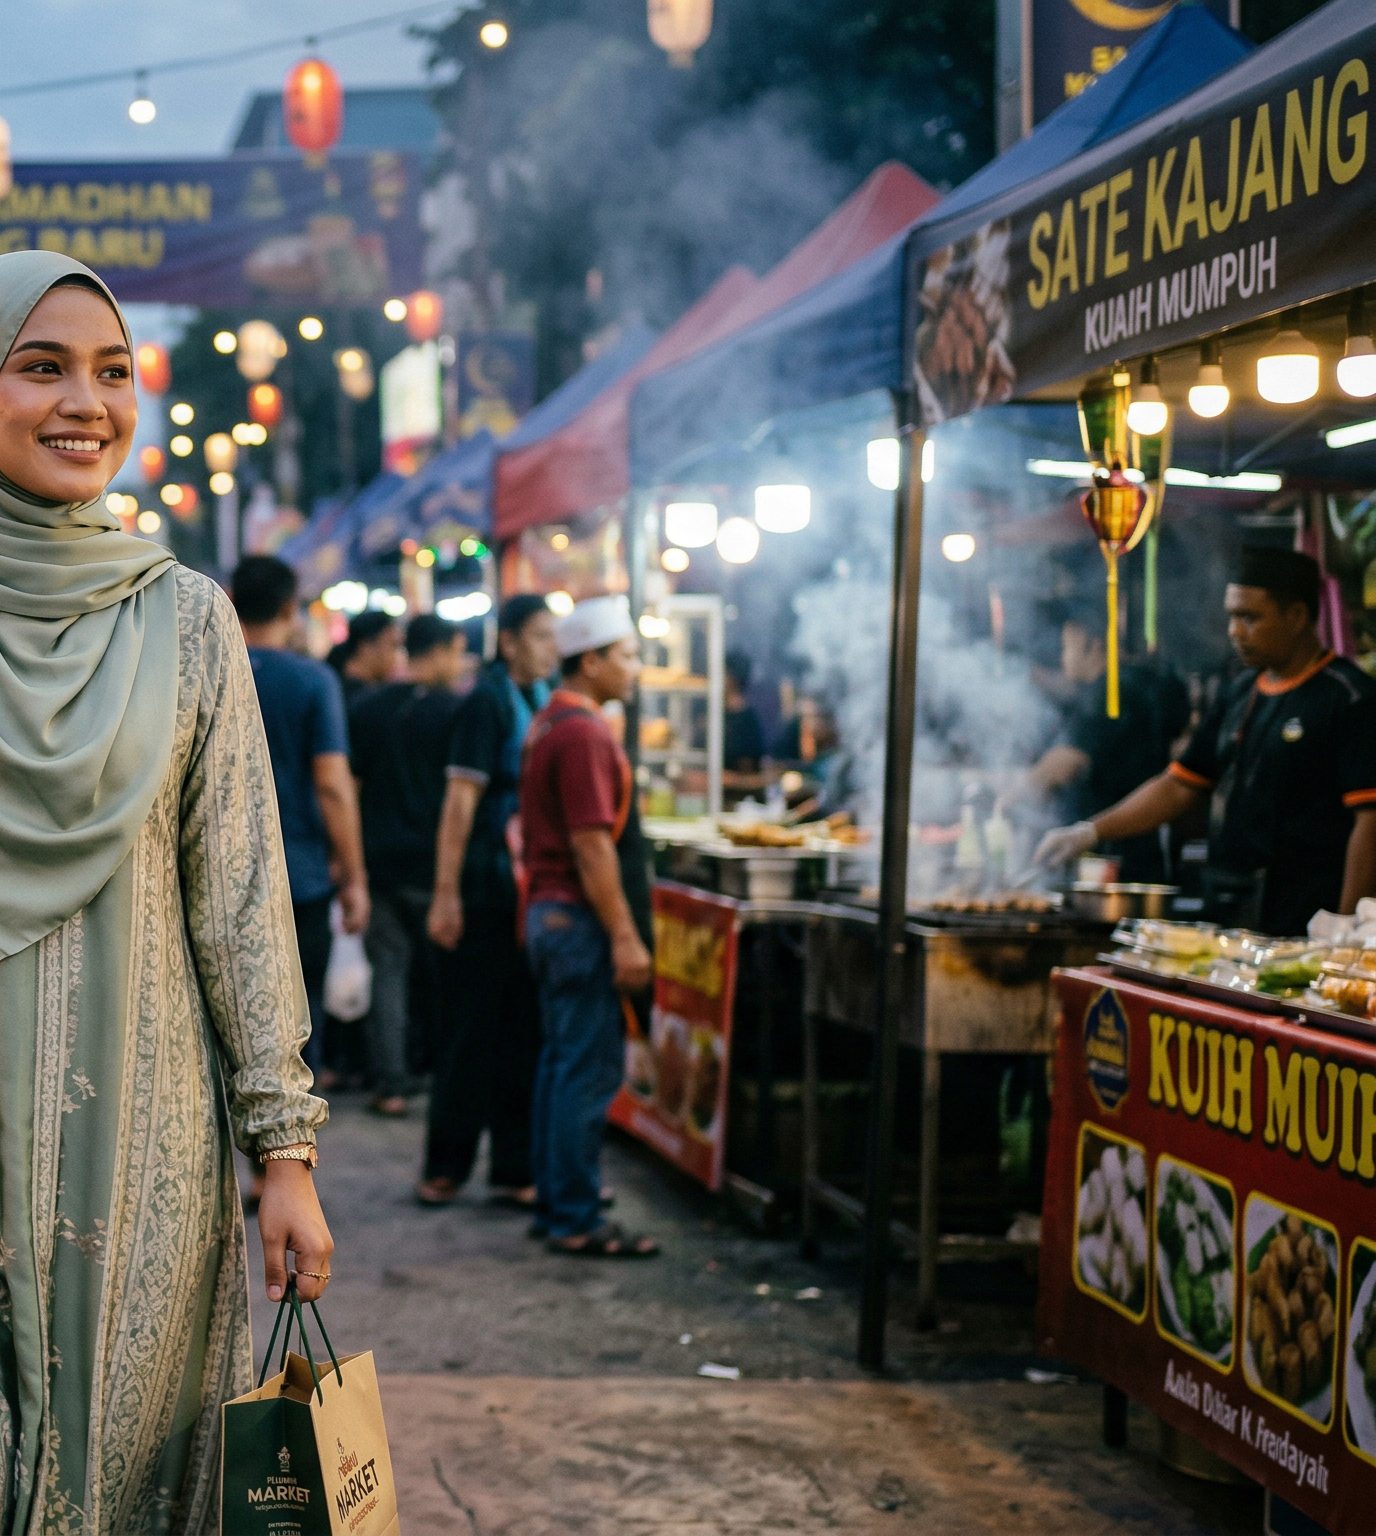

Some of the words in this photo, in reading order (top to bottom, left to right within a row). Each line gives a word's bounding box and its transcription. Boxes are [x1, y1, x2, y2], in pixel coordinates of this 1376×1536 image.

[1027, 168, 1132, 310] SATE
[1142, 58, 1370, 263] KAJANG
[1085, 281, 1153, 355] KUAIH
[1157, 236, 1277, 328] MUMPUH
[1148, 1012, 1254, 1134] KUIH
[247, 1485, 311, 1504] MARKET
